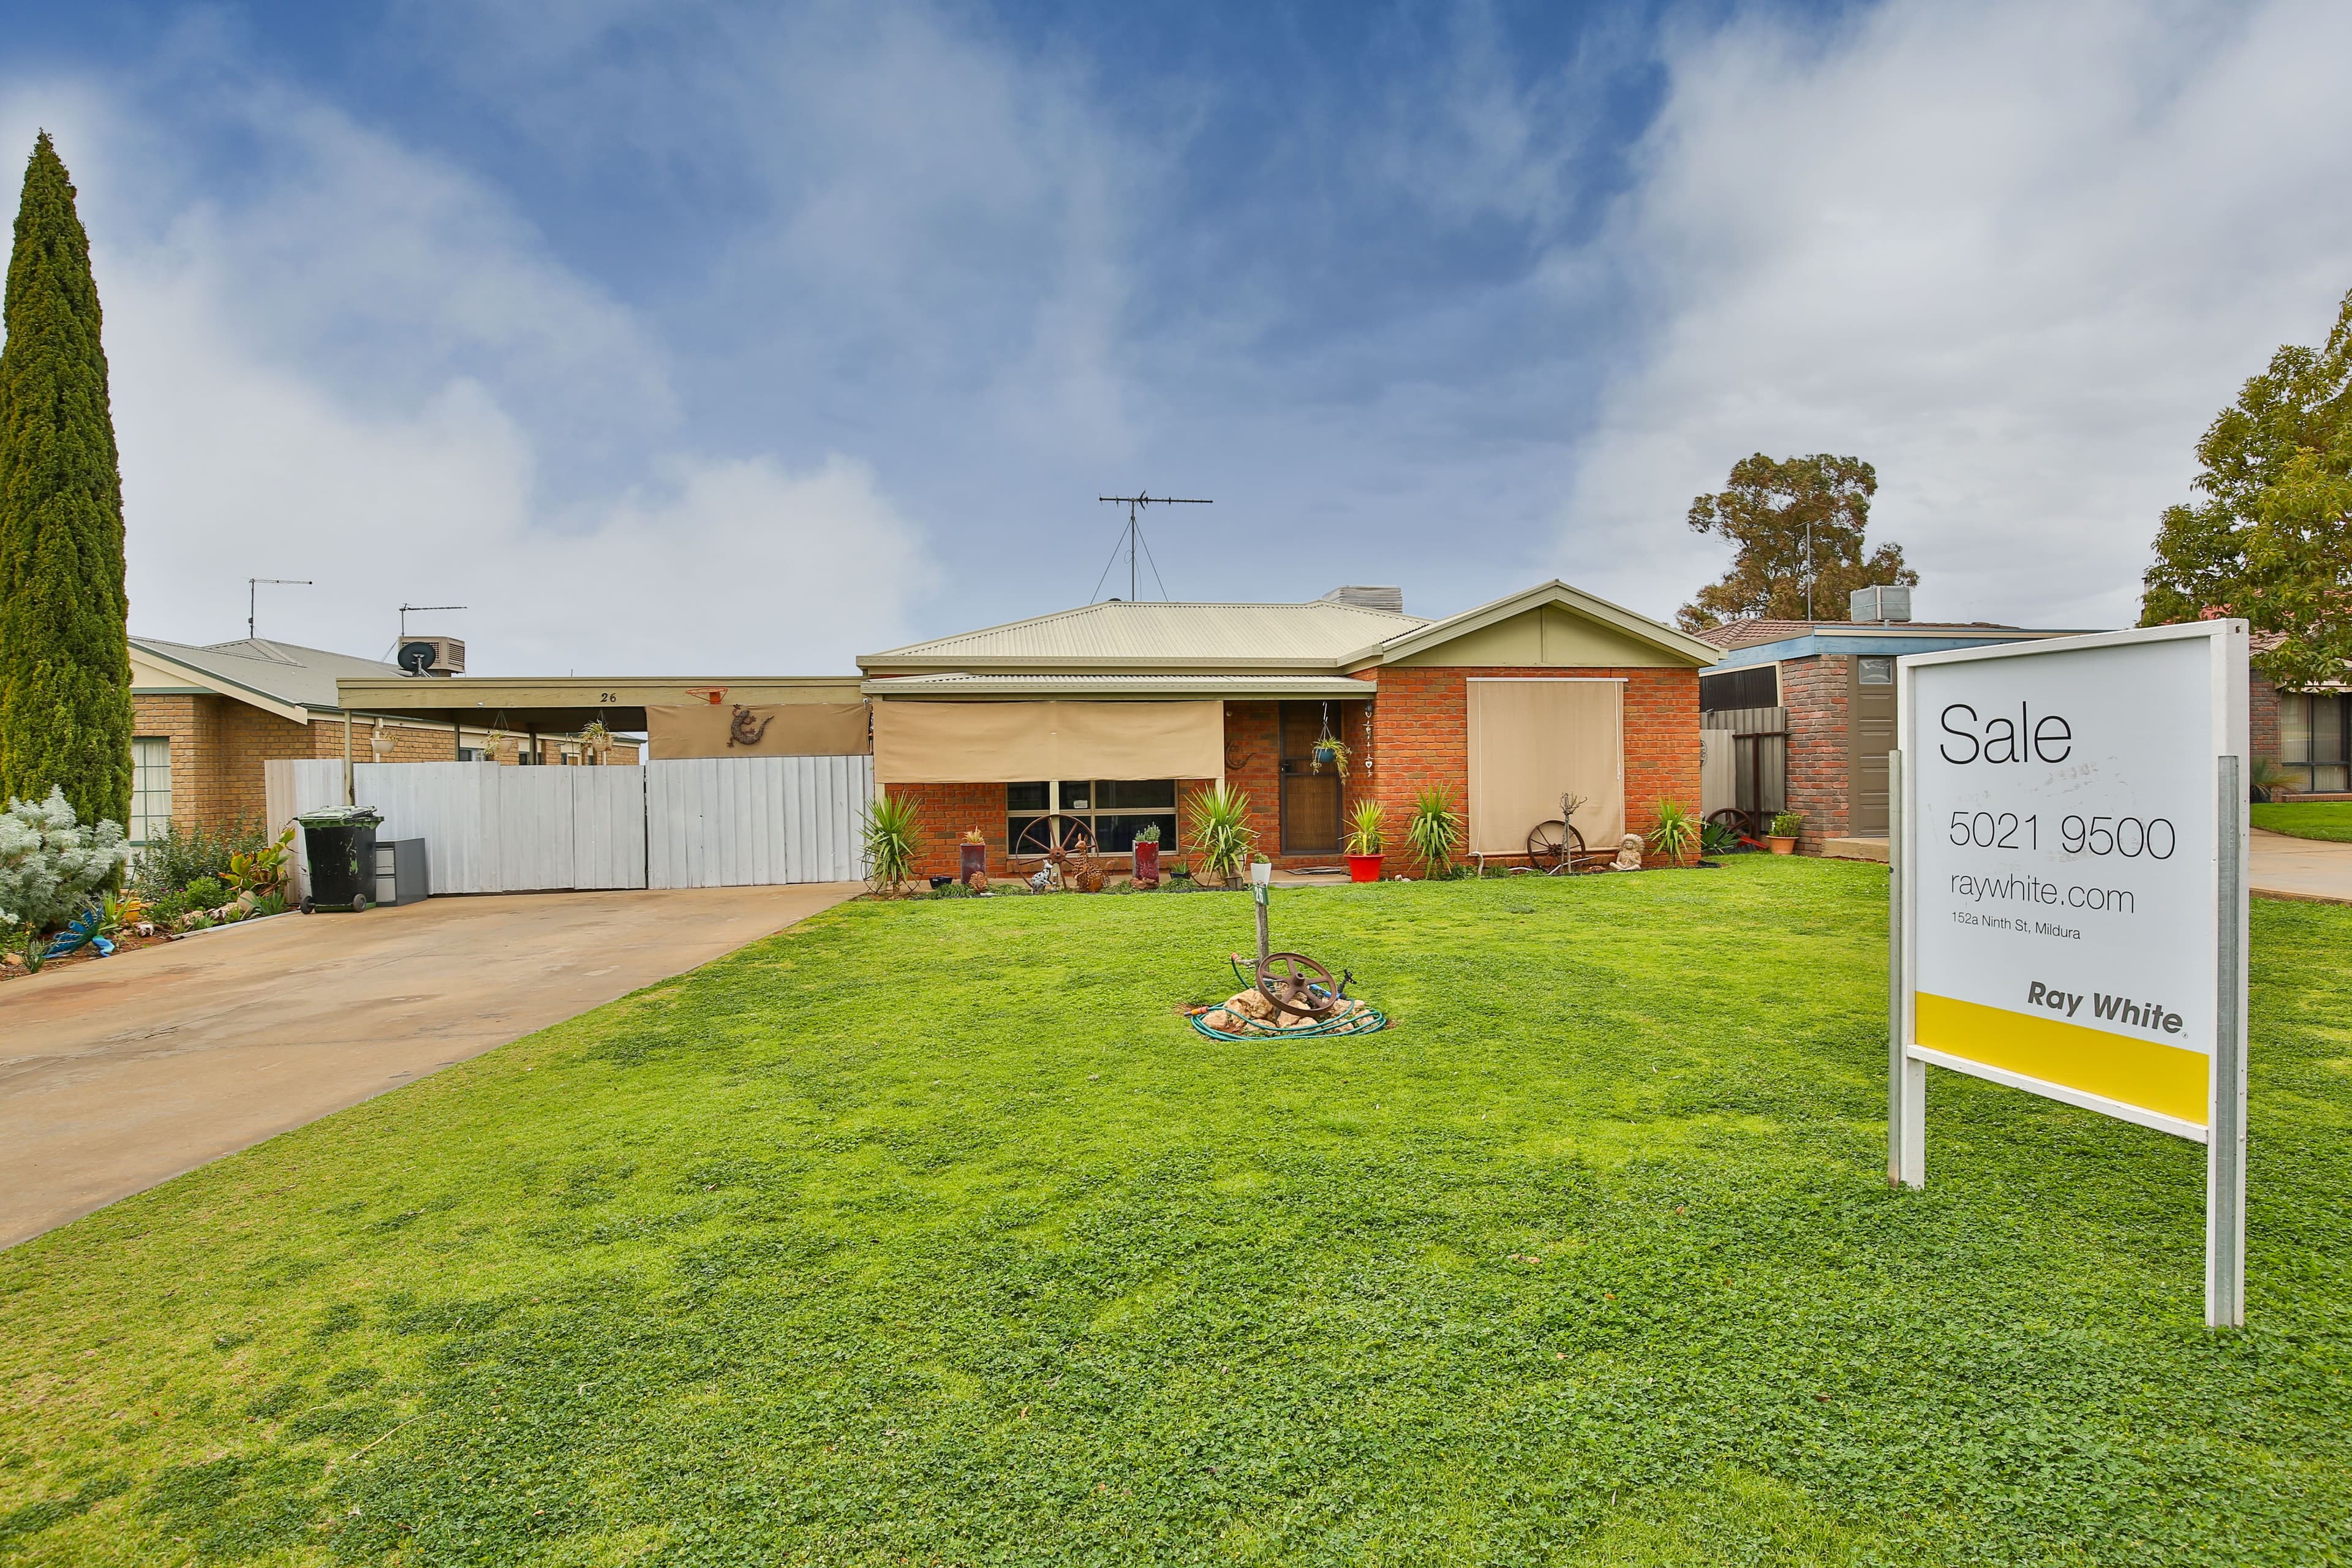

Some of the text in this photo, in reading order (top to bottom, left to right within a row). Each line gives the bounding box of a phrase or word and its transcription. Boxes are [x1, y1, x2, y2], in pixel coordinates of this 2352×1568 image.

[600, 692, 617, 703] 26
[1940, 701, 2071, 765] Sale
[1950, 811, 2176, 859] 5021 9500
[1254, 886, 1264, 903] 26
[1951, 872, 2134, 913] raywhite.com
[1952, 911, 2081, 940] 152a Ninth St, Mildura
[2027, 981, 2183, 1034] Ray White
